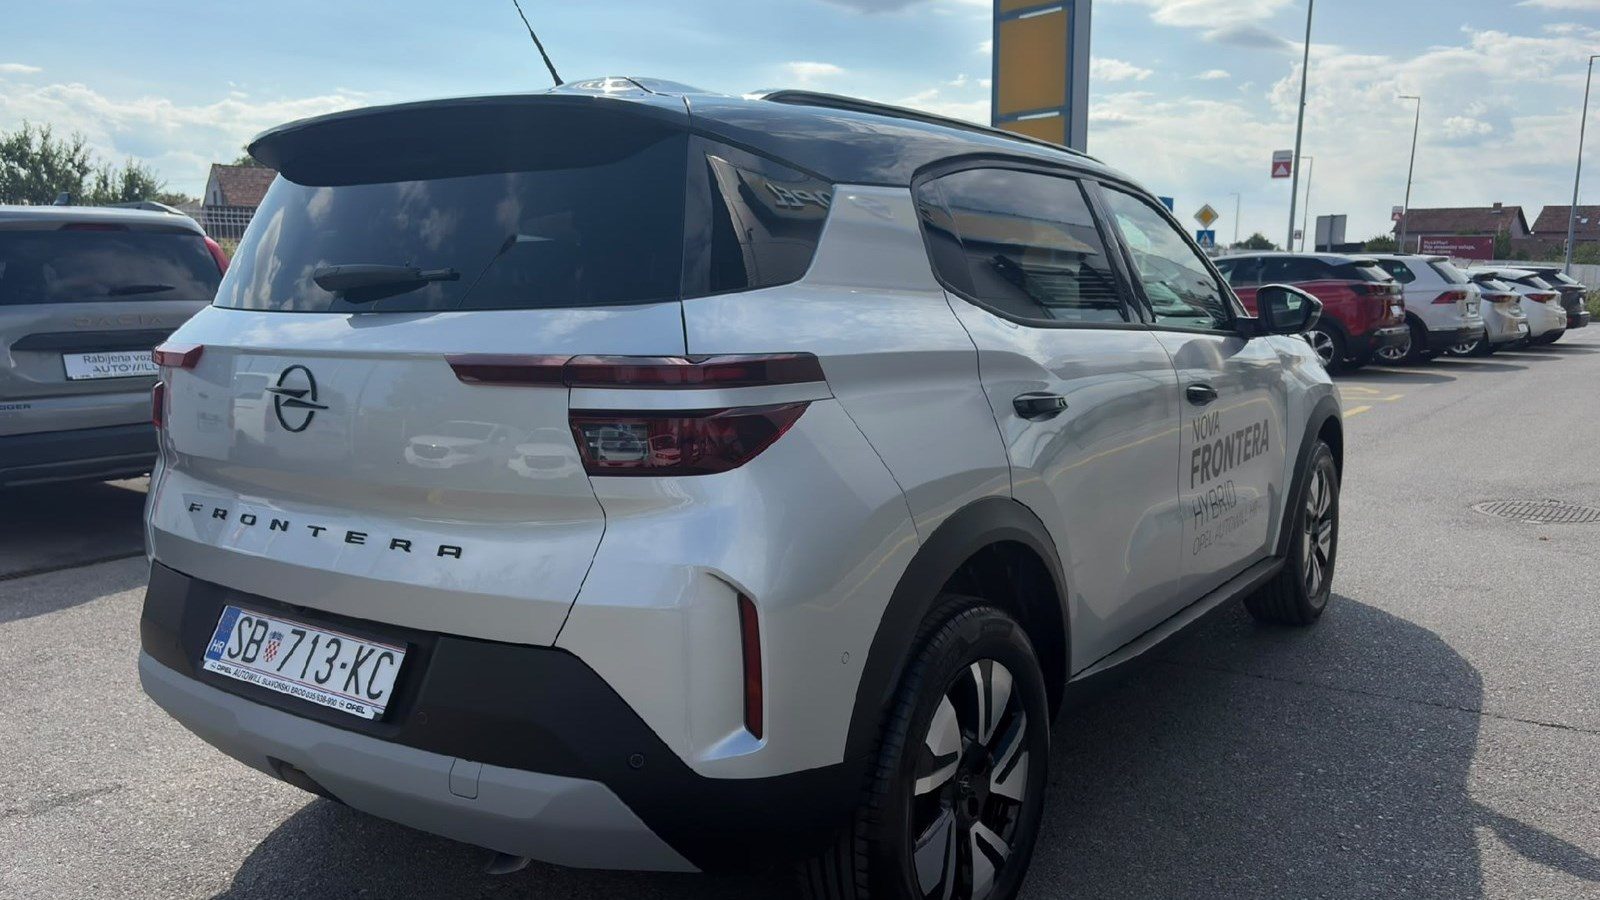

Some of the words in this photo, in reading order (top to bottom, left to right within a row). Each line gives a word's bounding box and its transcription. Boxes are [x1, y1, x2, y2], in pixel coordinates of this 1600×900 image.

[73, 313, 162, 328] DACIA
[132, 354, 152, 362] voz
[1192, 411, 1220, 443] NOVA
[1190, 419, 1269, 489] FRONTERA
[1192, 480, 1237, 530] HYBRID
[188, 502, 463, 559] FRONTERA
[212, 640, 224, 653] HR
[227, 616, 269, 663] SB
[276, 628, 394, 700] 713-KC
[216, 664, 232, 674] OPEL
[233, 669, 262, 684] AUTOWILL
[261, 678, 291, 692] SLAVONSKI
[290, 686, 306, 697] BROD
[345, 702, 366, 714] OPEL
